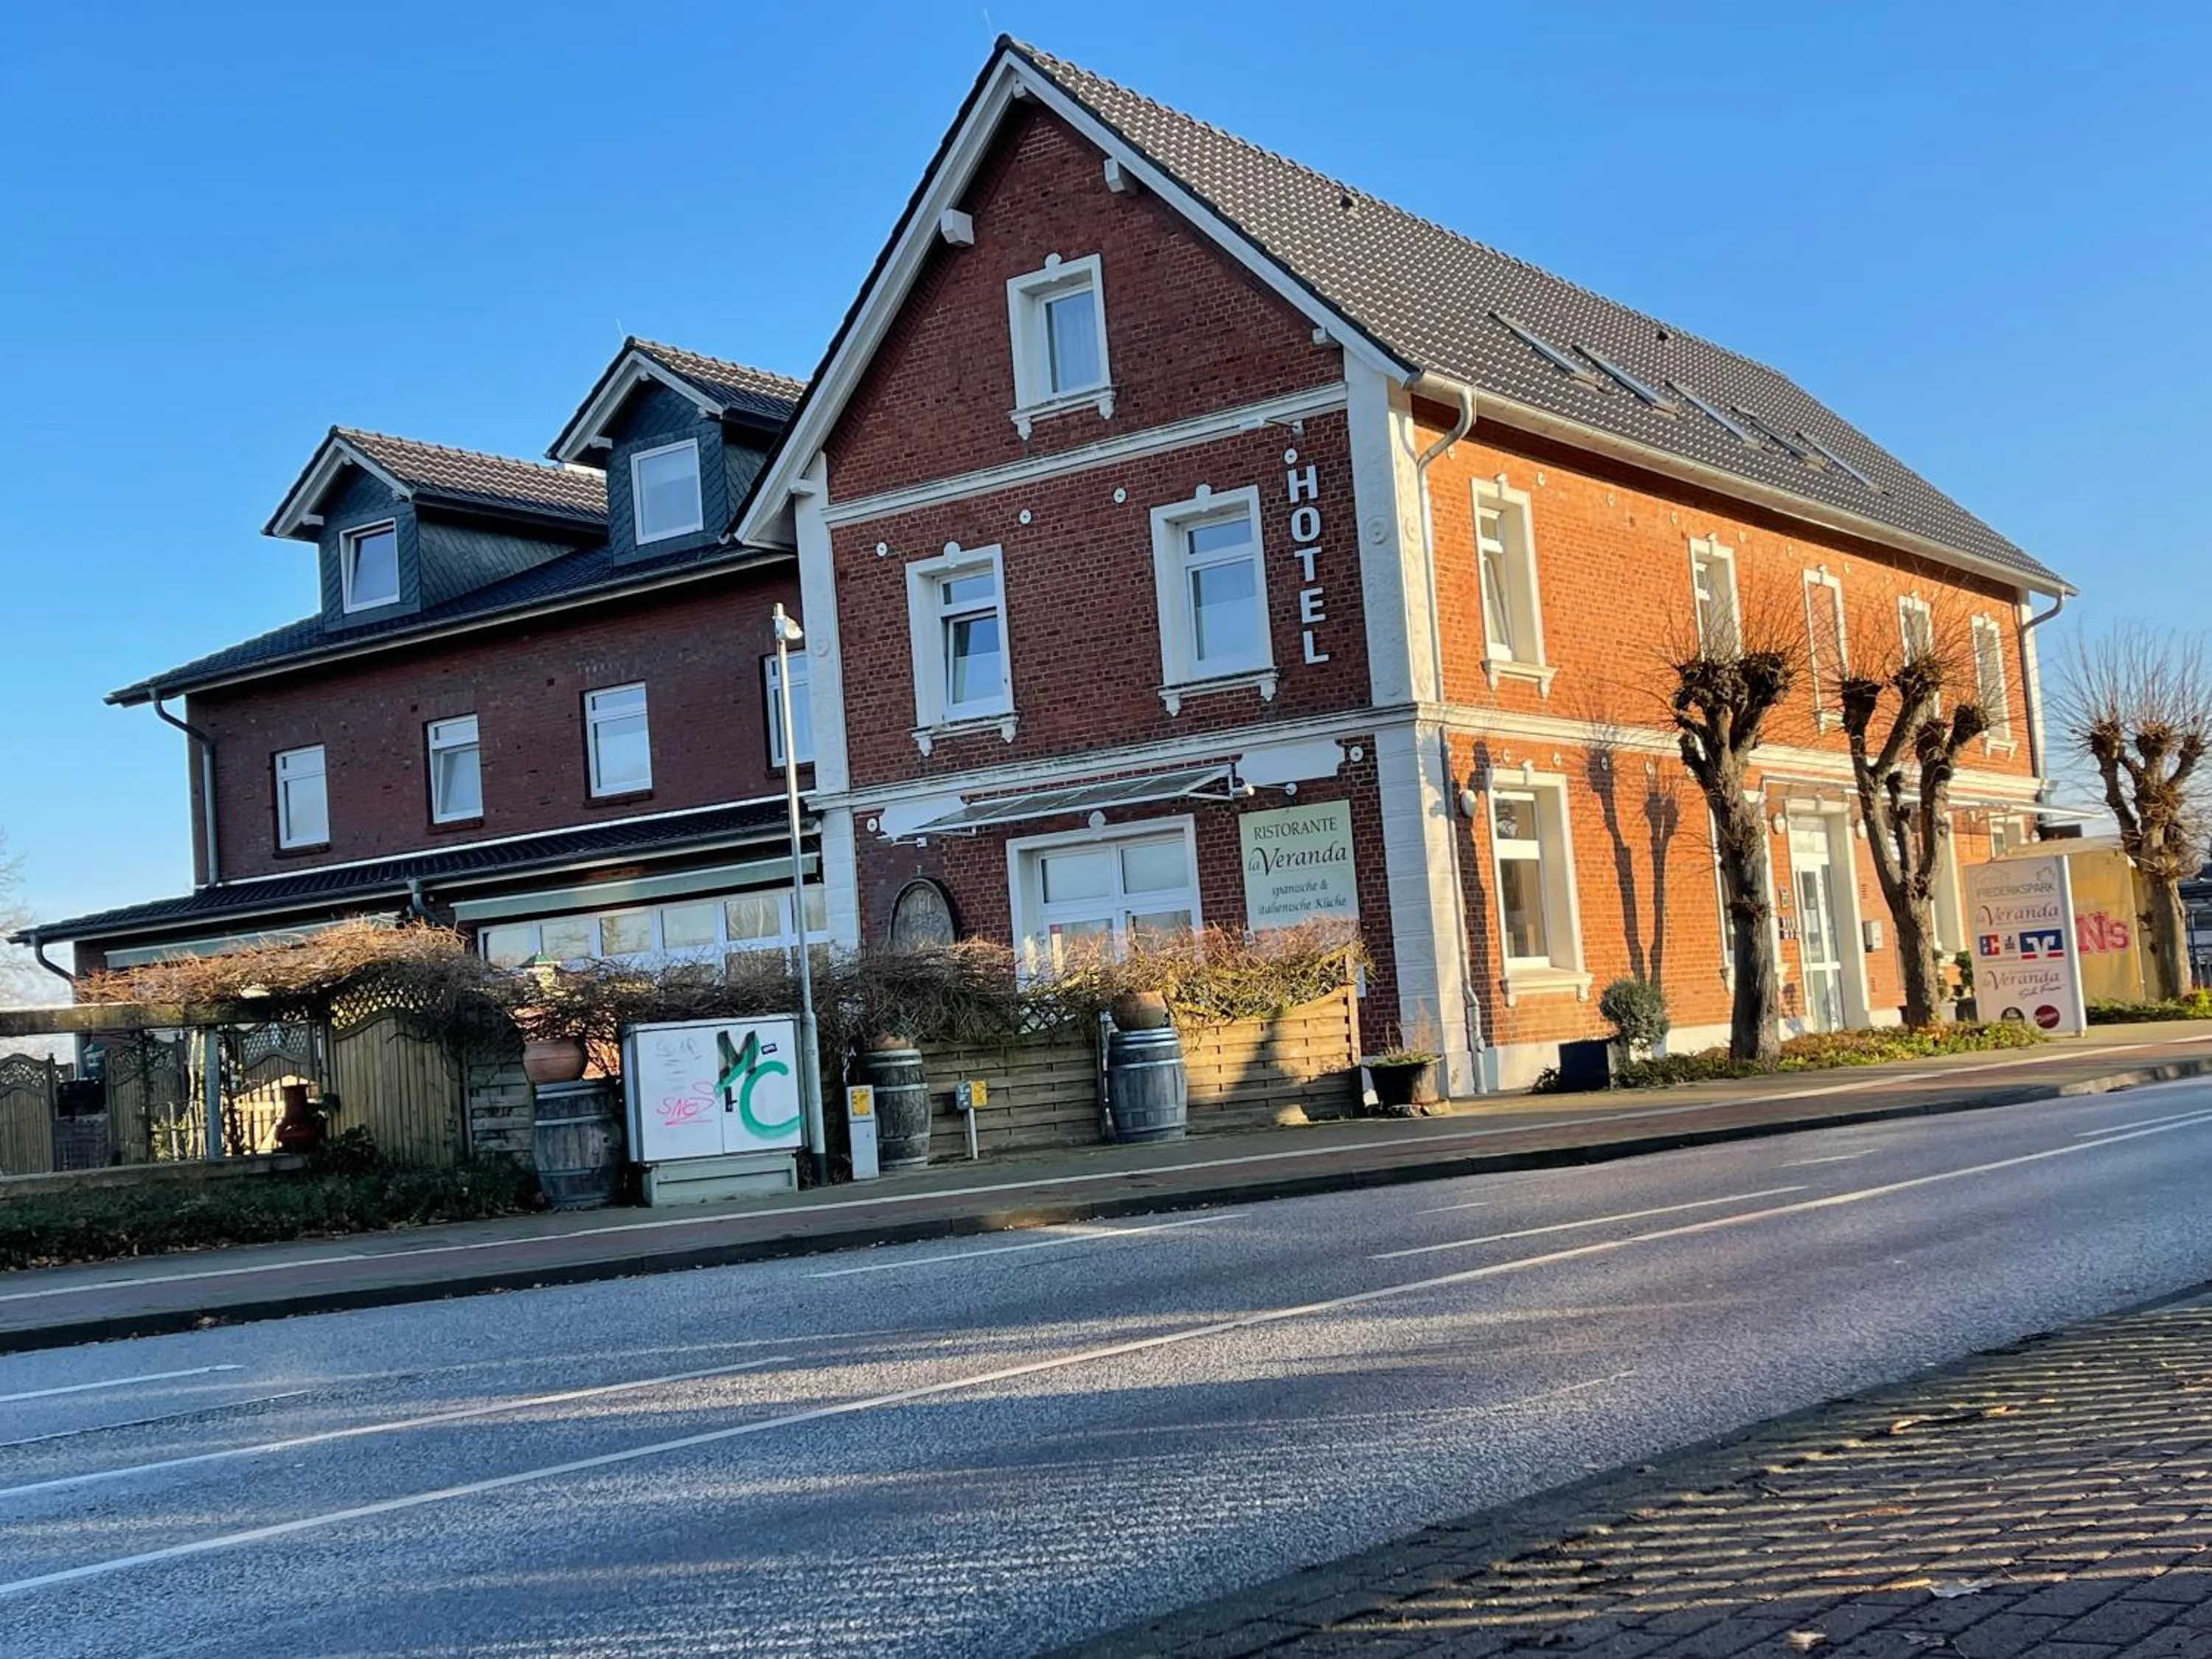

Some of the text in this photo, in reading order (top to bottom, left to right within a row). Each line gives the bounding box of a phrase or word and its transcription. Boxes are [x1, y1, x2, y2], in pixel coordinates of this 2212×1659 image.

[1287, 465, 1329, 664] HOTEL
[1253, 816, 1338, 840] RISTORANTE
[1248, 840, 1346, 876] la Veranda
[1272, 880, 1318, 899] spanische
[1258, 900, 1312, 915] italienische
[1980, 902, 2059, 926] Veranda
[1988, 968, 2061, 991] Veranda
